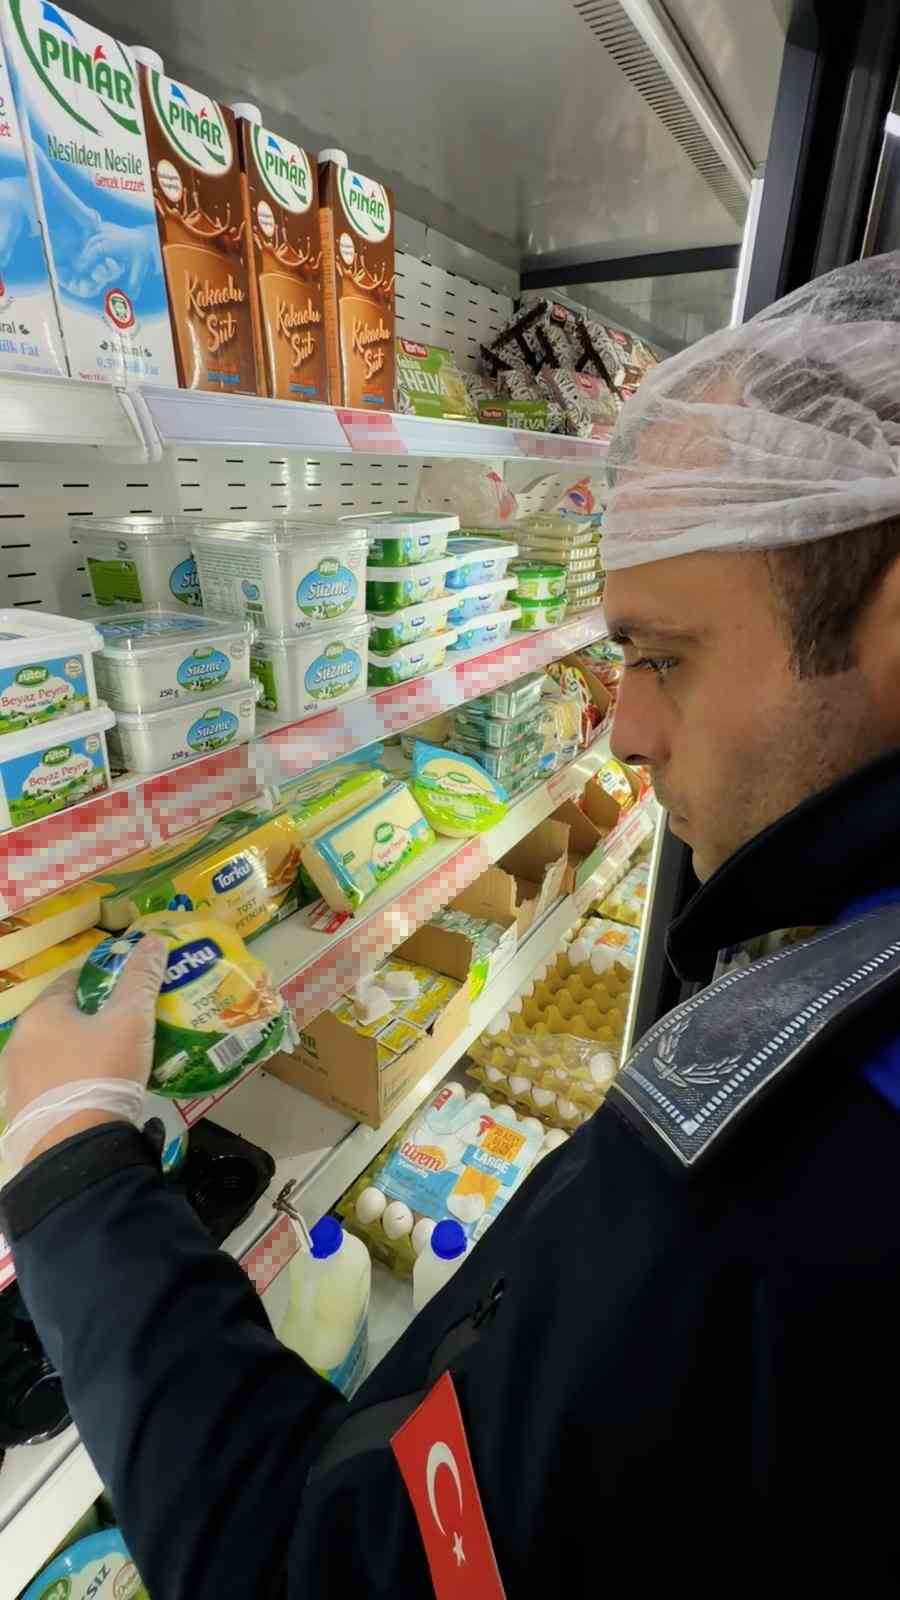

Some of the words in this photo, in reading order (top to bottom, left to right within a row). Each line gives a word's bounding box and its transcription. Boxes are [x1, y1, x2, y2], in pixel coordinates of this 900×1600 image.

[38, 27, 136, 110] PINAR
[168, 101, 224, 149] PINAR
[48, 134, 102, 169] Nesilden
[104, 148, 143, 176] Nesile
[264, 153, 307, 190] PINAR
[349, 189, 385, 220] PINAR
[184, 270, 245, 318] Kakaolu
[206, 312, 238, 352] Süt
[275, 296, 322, 337] Kakaolu
[291, 331, 316, 367] Süt
[351, 318, 391, 353] Kakaolu
[364, 349, 385, 380] Süt
[314, 661, 353, 683] Süzme
[1, 692, 36, 708] Beyaz
[30, 769, 59, 787] Beyaz
[214, 862, 250, 889] Torku
[163, 946, 216, 984] orku
[472, 1151, 509, 1175] LARGE
